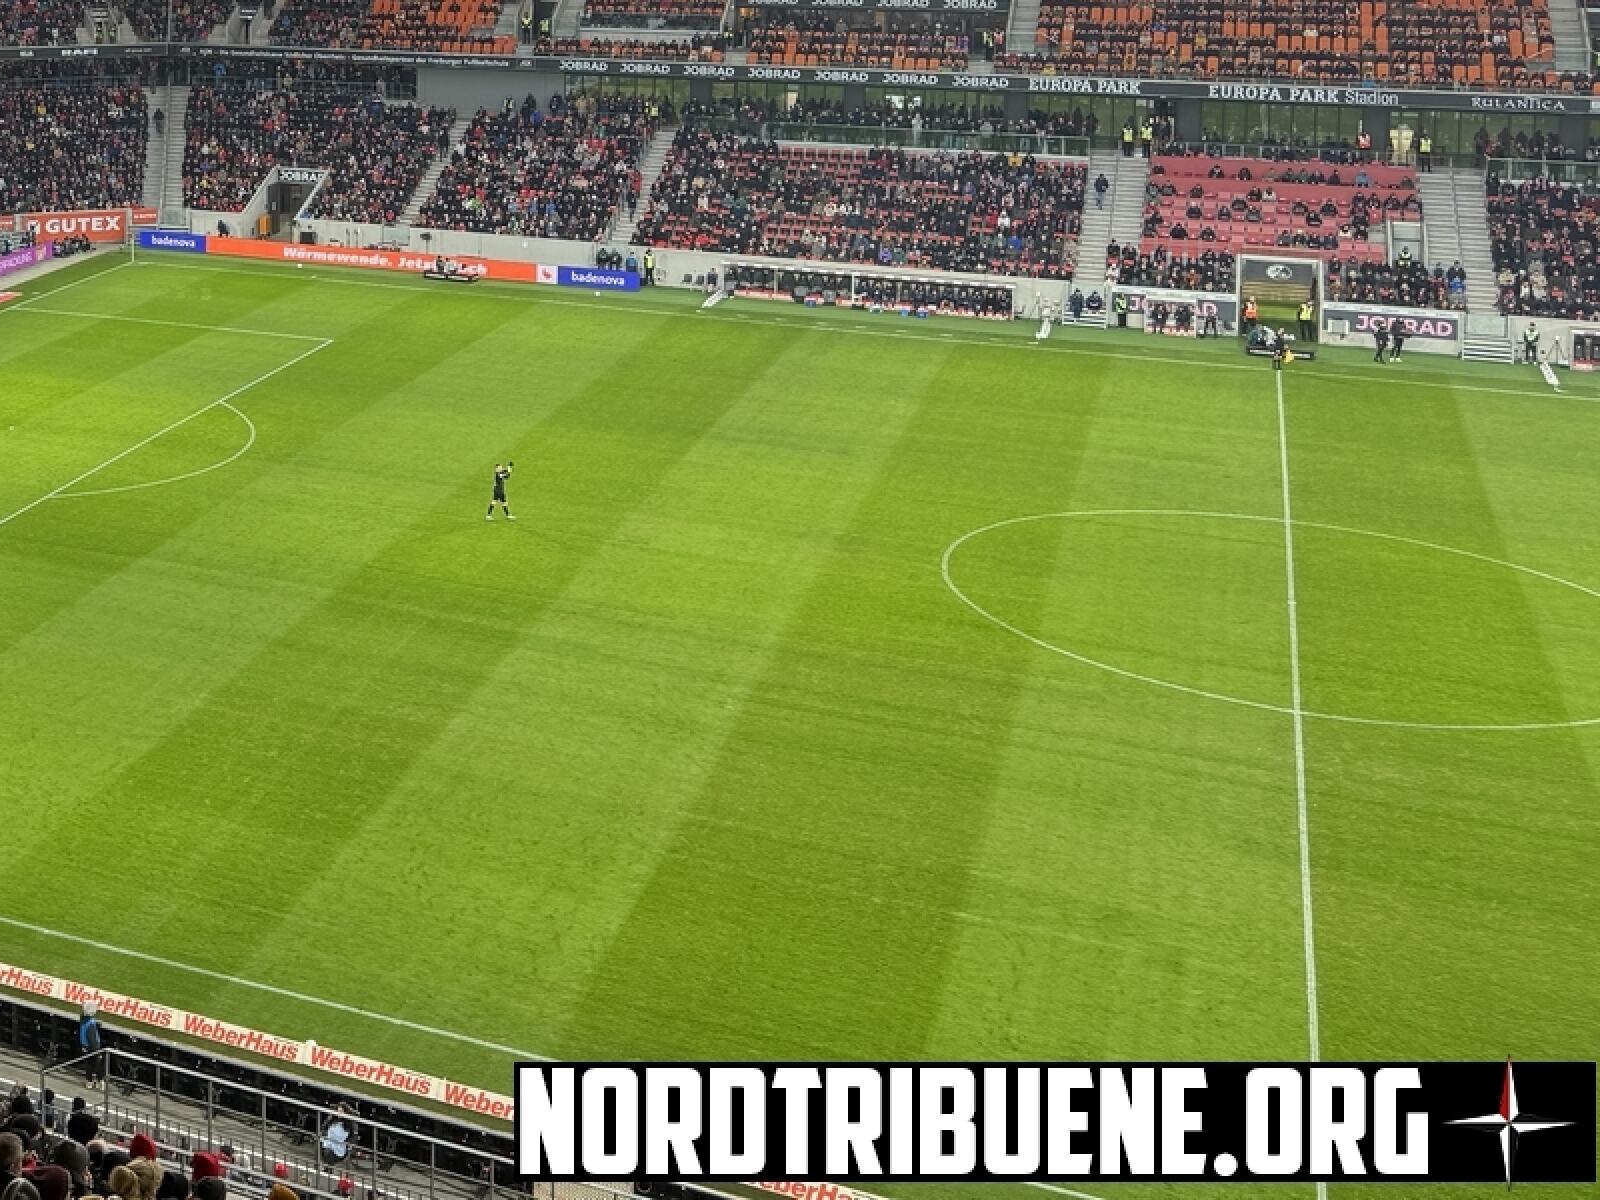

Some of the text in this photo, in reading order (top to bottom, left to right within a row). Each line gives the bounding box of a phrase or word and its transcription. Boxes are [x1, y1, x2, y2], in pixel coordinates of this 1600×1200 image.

[560, 60, 1009, 87] JOBRAD JOBRAD JOBRAD JOBRAD JOBRAD JOBRAD JOBRAD
[1029, 77, 1141, 94] EUROPA PARK
[1208, 85, 1399, 105] EUROPA PARK Stadion
[46, 215, 121, 234] GUTEX
[151, 233, 196, 248] badenova
[571, 269, 625, 287] badenova
[1356, 314, 1453, 337] JORAD
[64, 982, 173, 1029] WeberHaus
[183, 1013, 298, 1062] WeberHaus
[310, 1044, 432, 1096] WeberHaus
[444, 1081, 514, 1121] Weber
